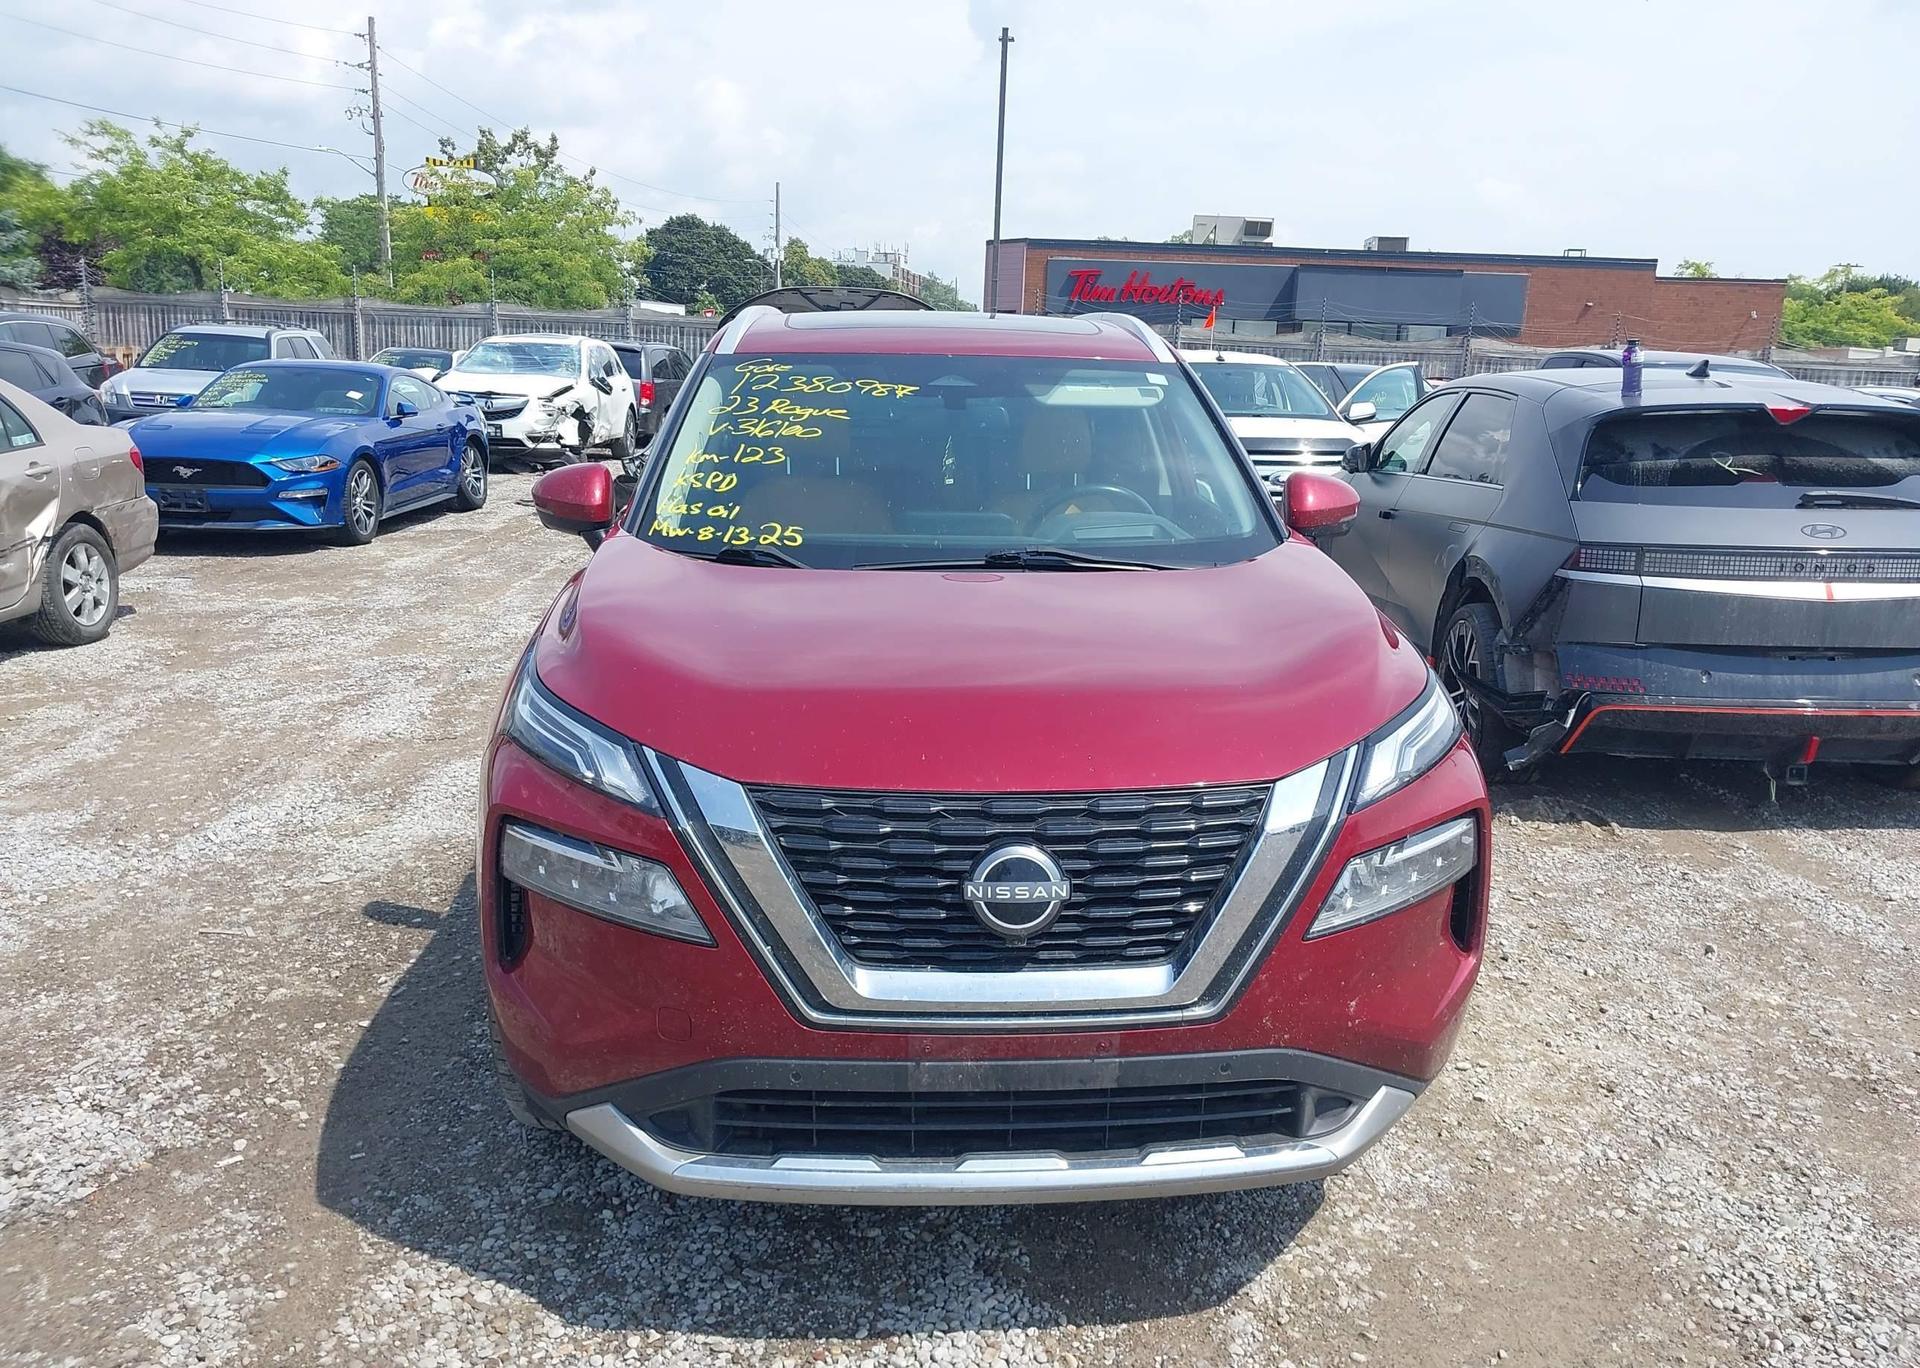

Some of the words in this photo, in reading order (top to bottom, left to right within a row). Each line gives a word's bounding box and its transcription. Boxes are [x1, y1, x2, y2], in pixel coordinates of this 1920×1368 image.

[1069, 269, 1116, 302] Tim
[1121, 270, 1225, 306] Hortons
[708, 396, 760, 415] 23
[762, 399, 851, 422] Rogue
[706, 502, 741, 520] oil
[967, 884, 1067, 899] NISSAN
